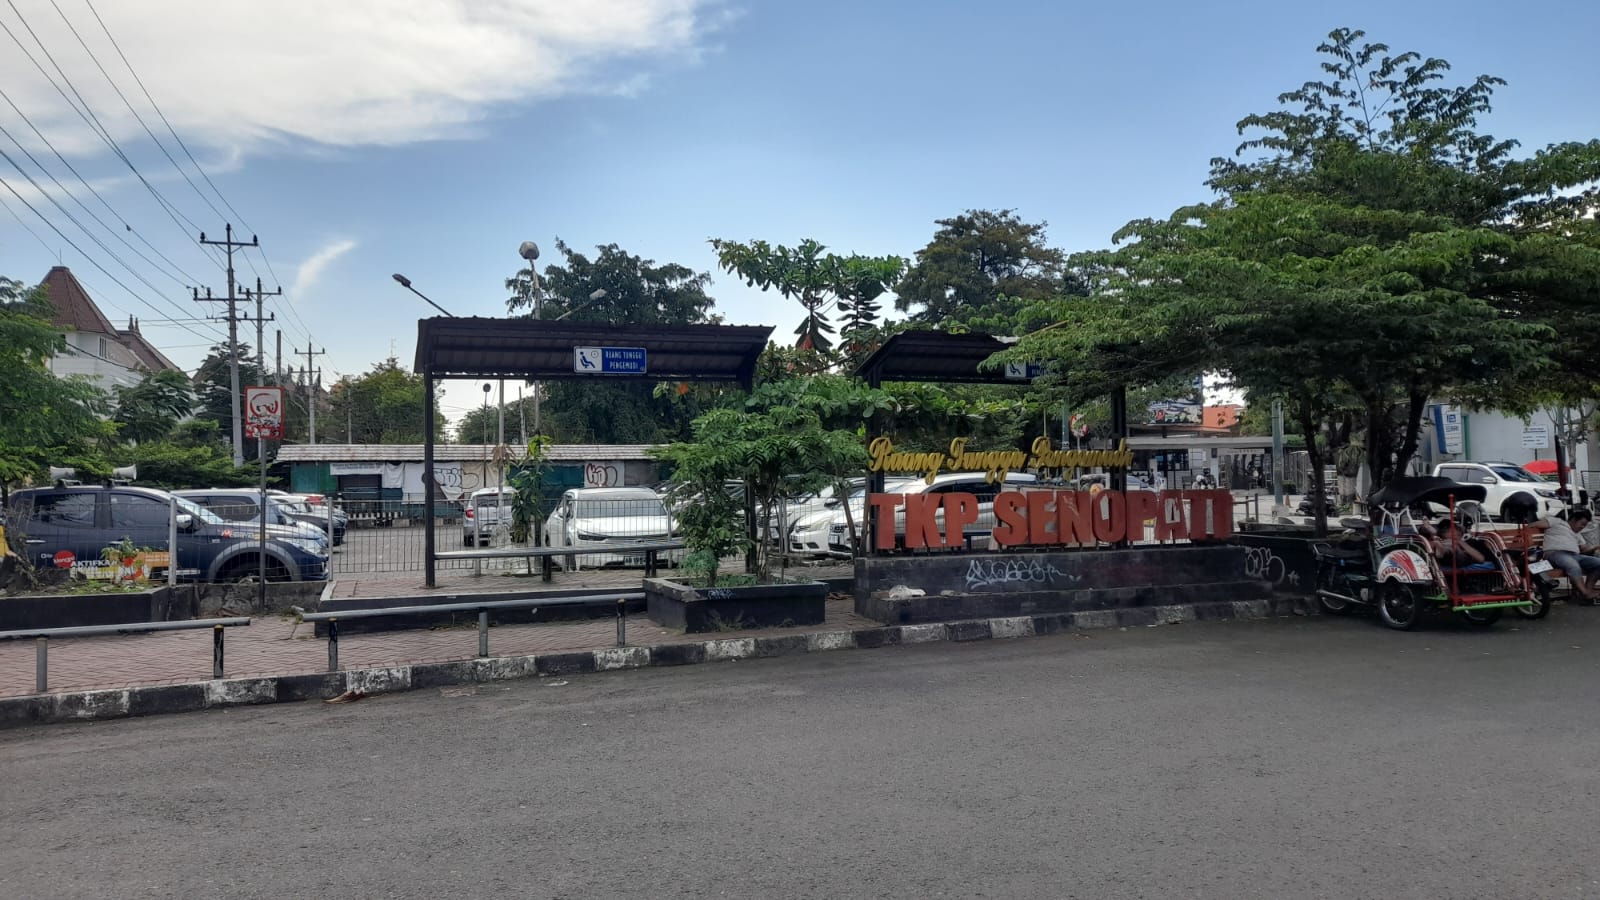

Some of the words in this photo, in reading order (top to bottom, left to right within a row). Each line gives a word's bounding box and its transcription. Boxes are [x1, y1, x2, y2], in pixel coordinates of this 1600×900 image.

[868, 437, 945, 485] Ruang
[947, 437, 1027, 484] Tunggu
[869, 493, 979, 550] TKP
[993, 489, 1233, 545] SENOPATI
